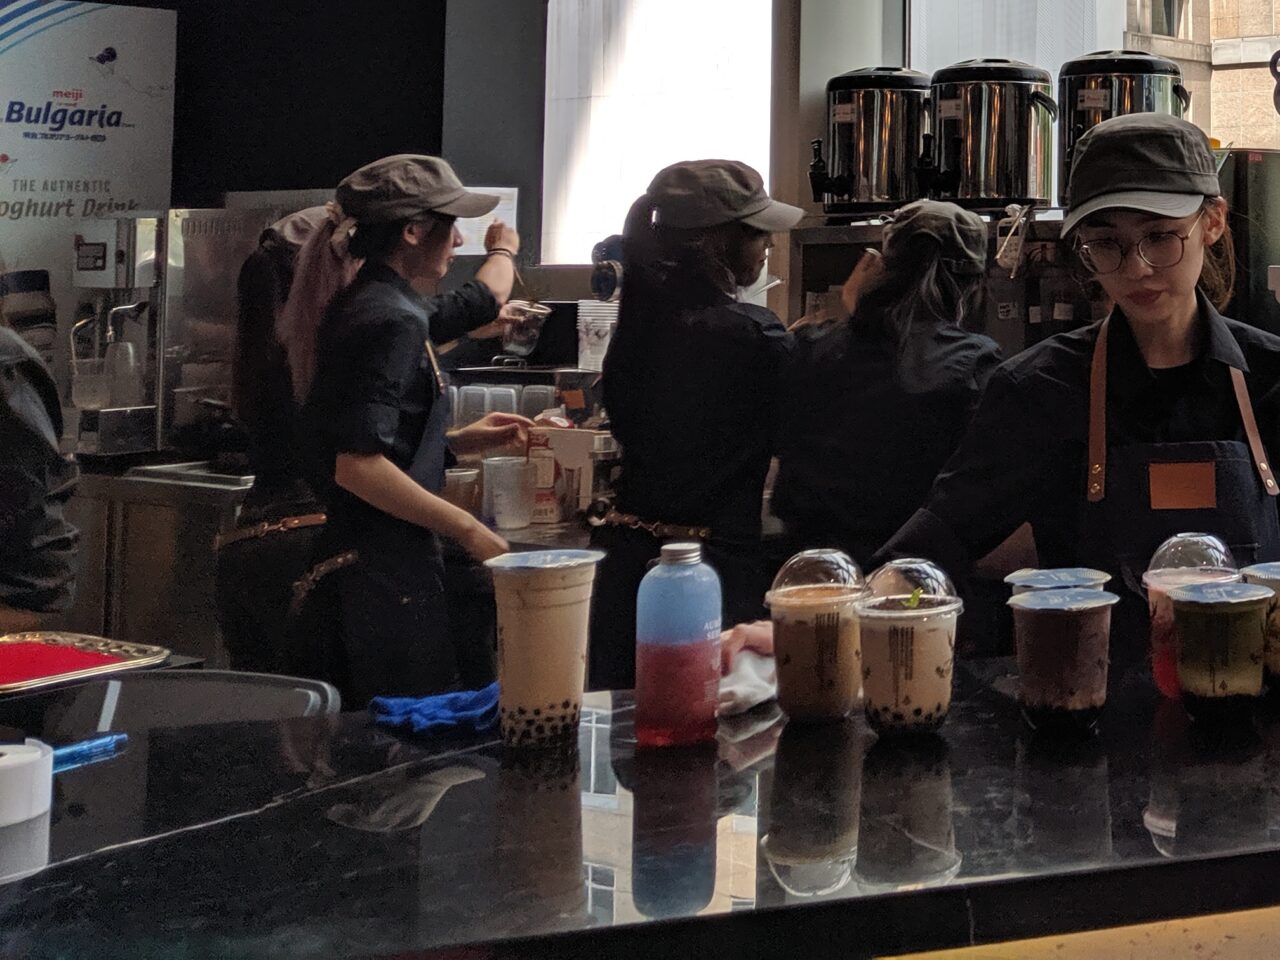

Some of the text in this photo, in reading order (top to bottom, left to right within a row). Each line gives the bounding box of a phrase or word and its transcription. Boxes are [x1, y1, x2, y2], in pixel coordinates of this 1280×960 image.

[53, 89, 84, 100] meiji
[6, 101, 122, 132] Bulgaria
[12, 180, 110, 192] THE AUTHENTIC
[0, 198, 138, 219] oghurt Drink
